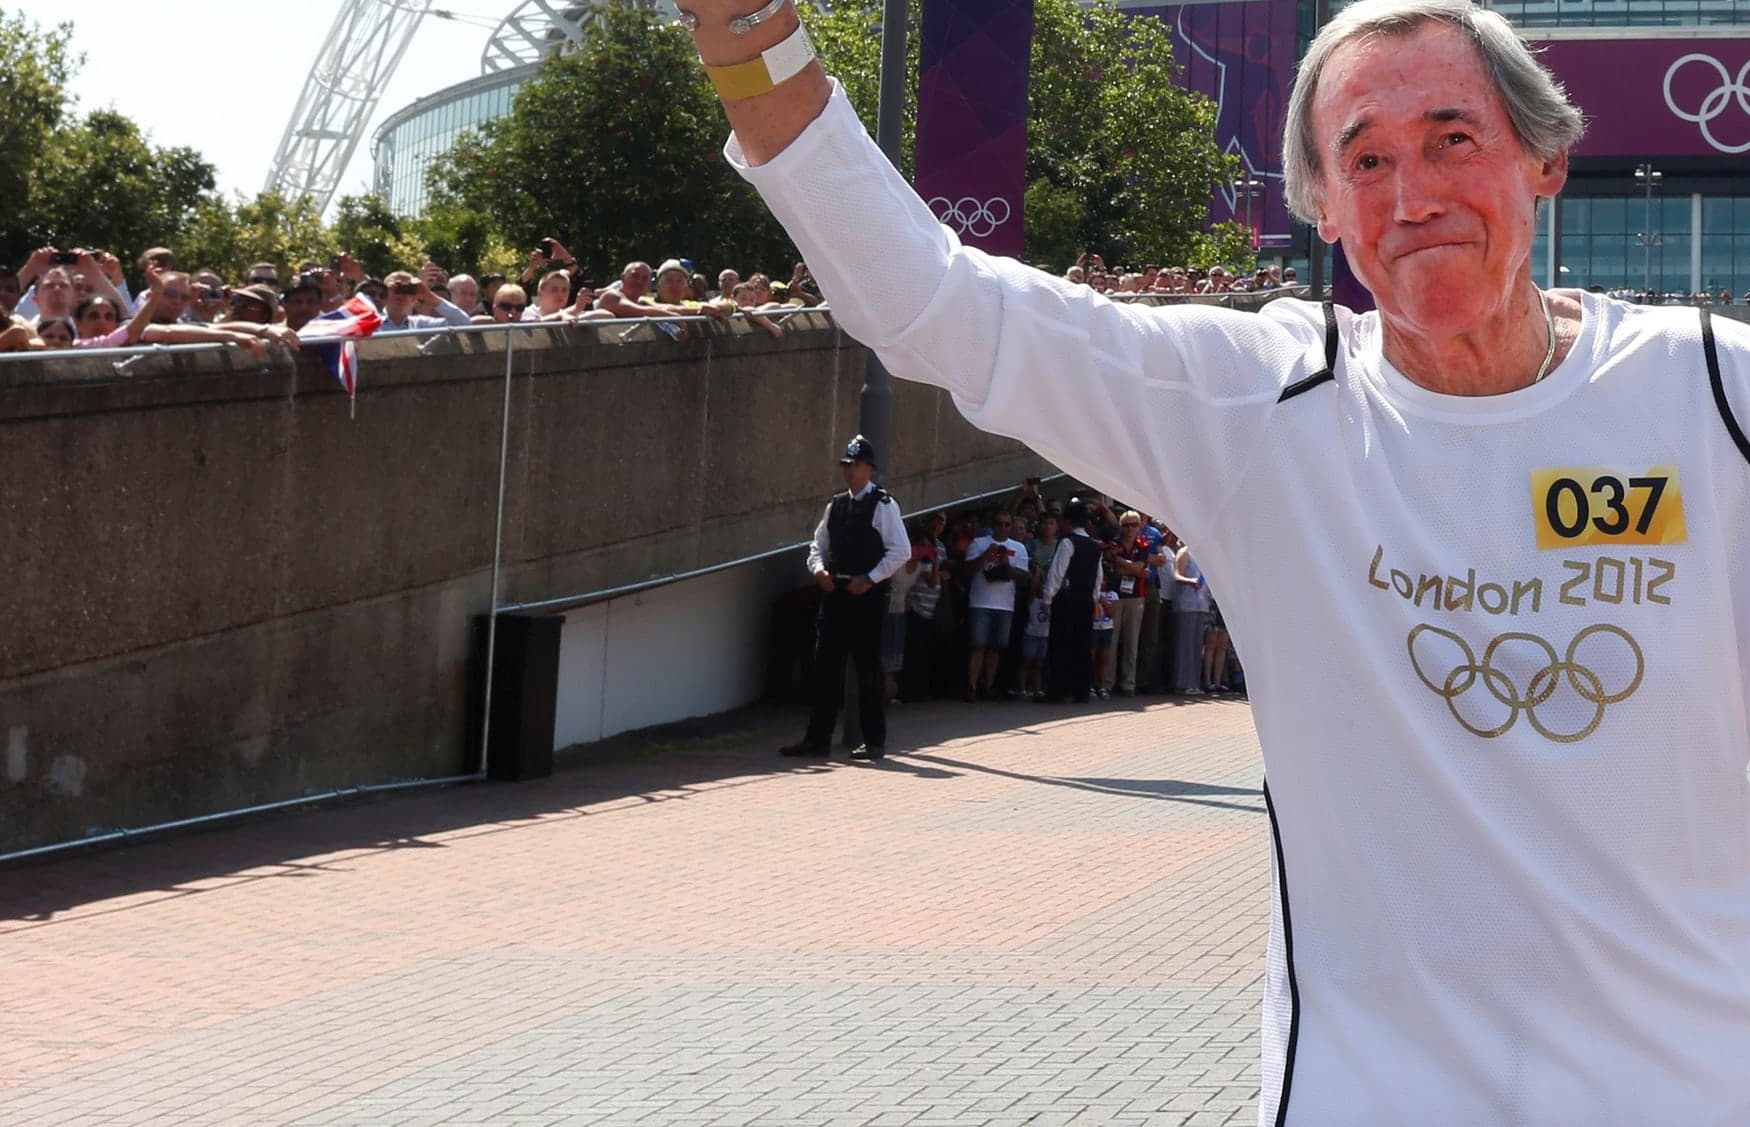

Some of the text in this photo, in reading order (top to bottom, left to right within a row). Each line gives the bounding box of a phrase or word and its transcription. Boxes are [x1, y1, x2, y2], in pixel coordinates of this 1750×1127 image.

[1545, 476, 1669, 538] 037
[1368, 543, 1676, 616] London 2012
